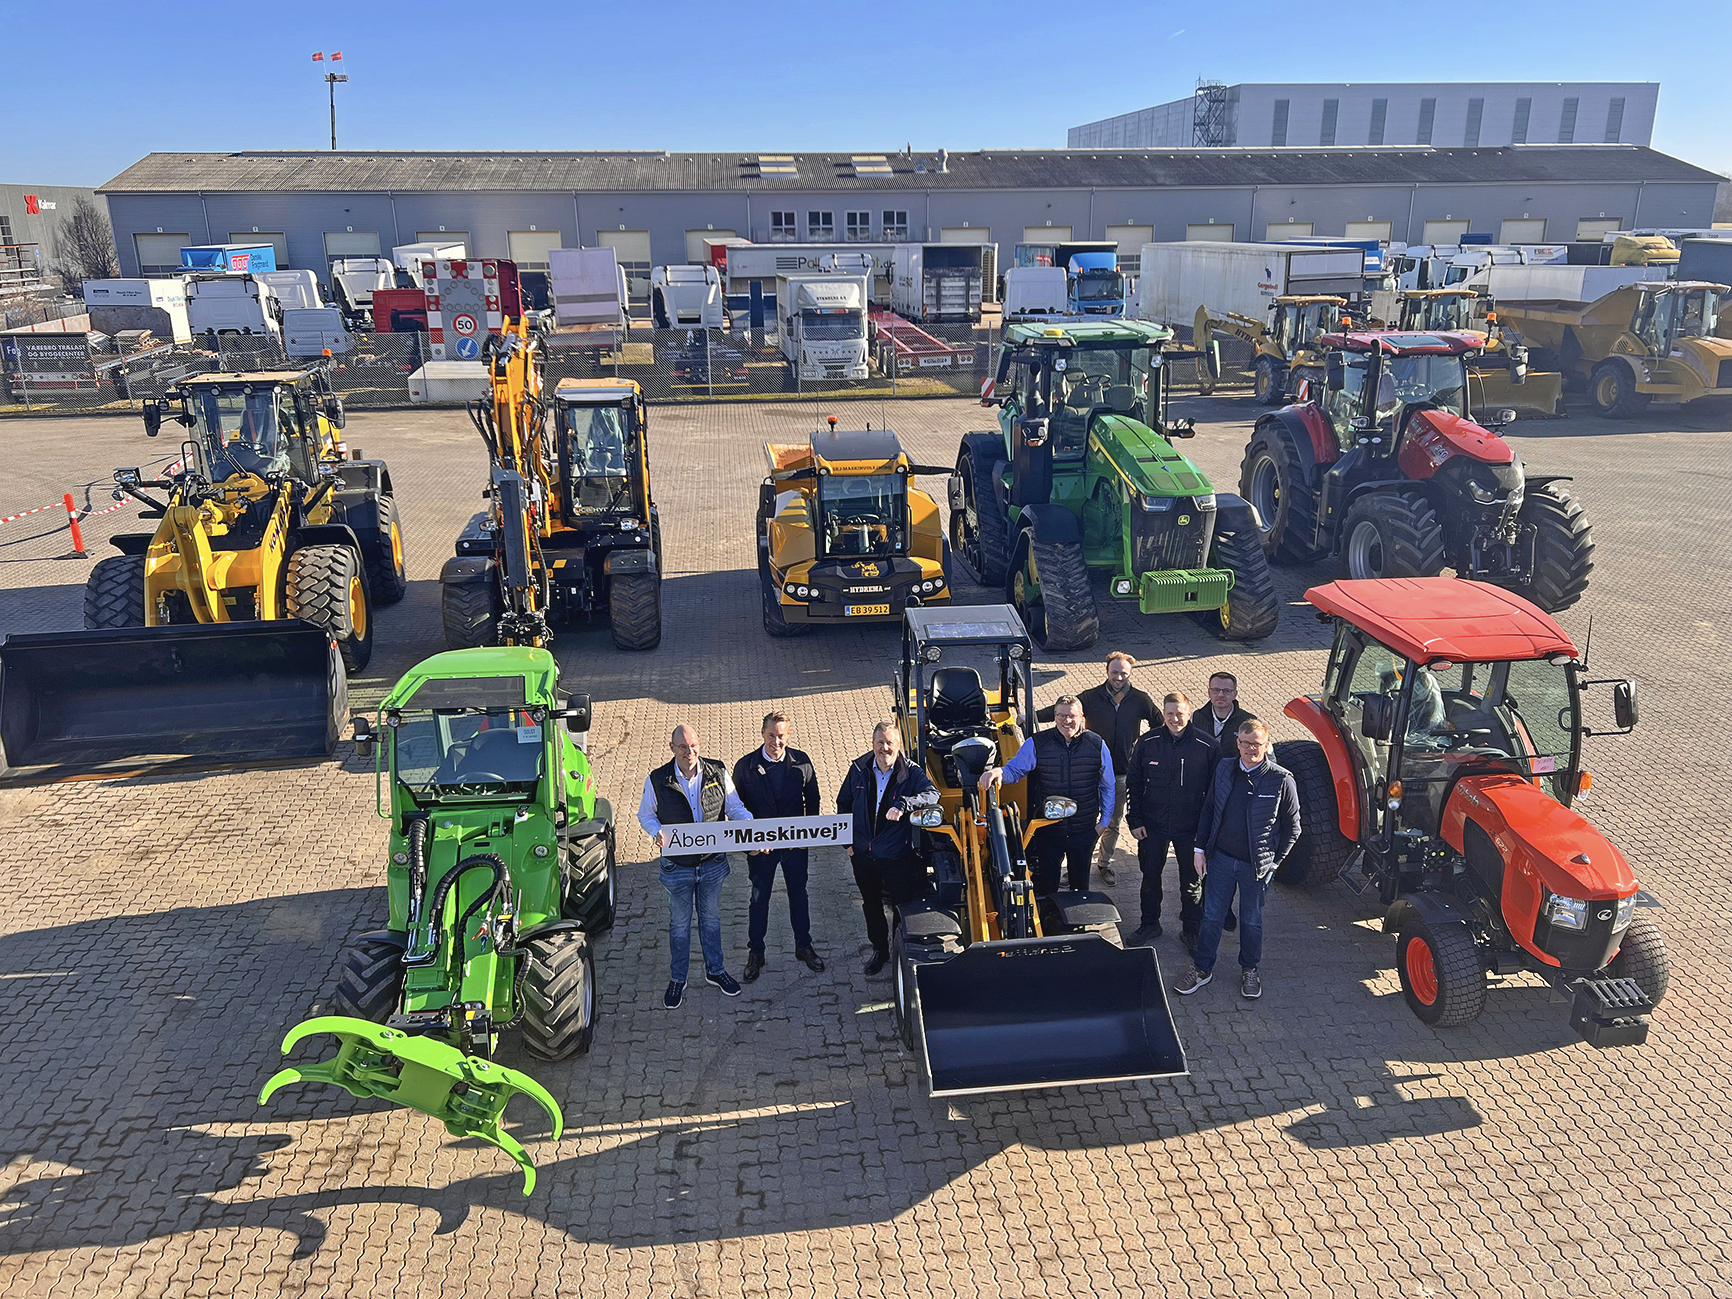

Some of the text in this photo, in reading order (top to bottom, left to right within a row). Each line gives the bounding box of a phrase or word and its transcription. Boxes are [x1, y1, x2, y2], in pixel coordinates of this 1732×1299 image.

[457, 320, 473, 330] 50
[850, 585, 883, 593] HYDREMA
[862, 606, 873, 614] 39
[874, 605, 888, 614] 512
[668, 829, 716, 848] Åben
[1496, 838, 1508, 853] 622
